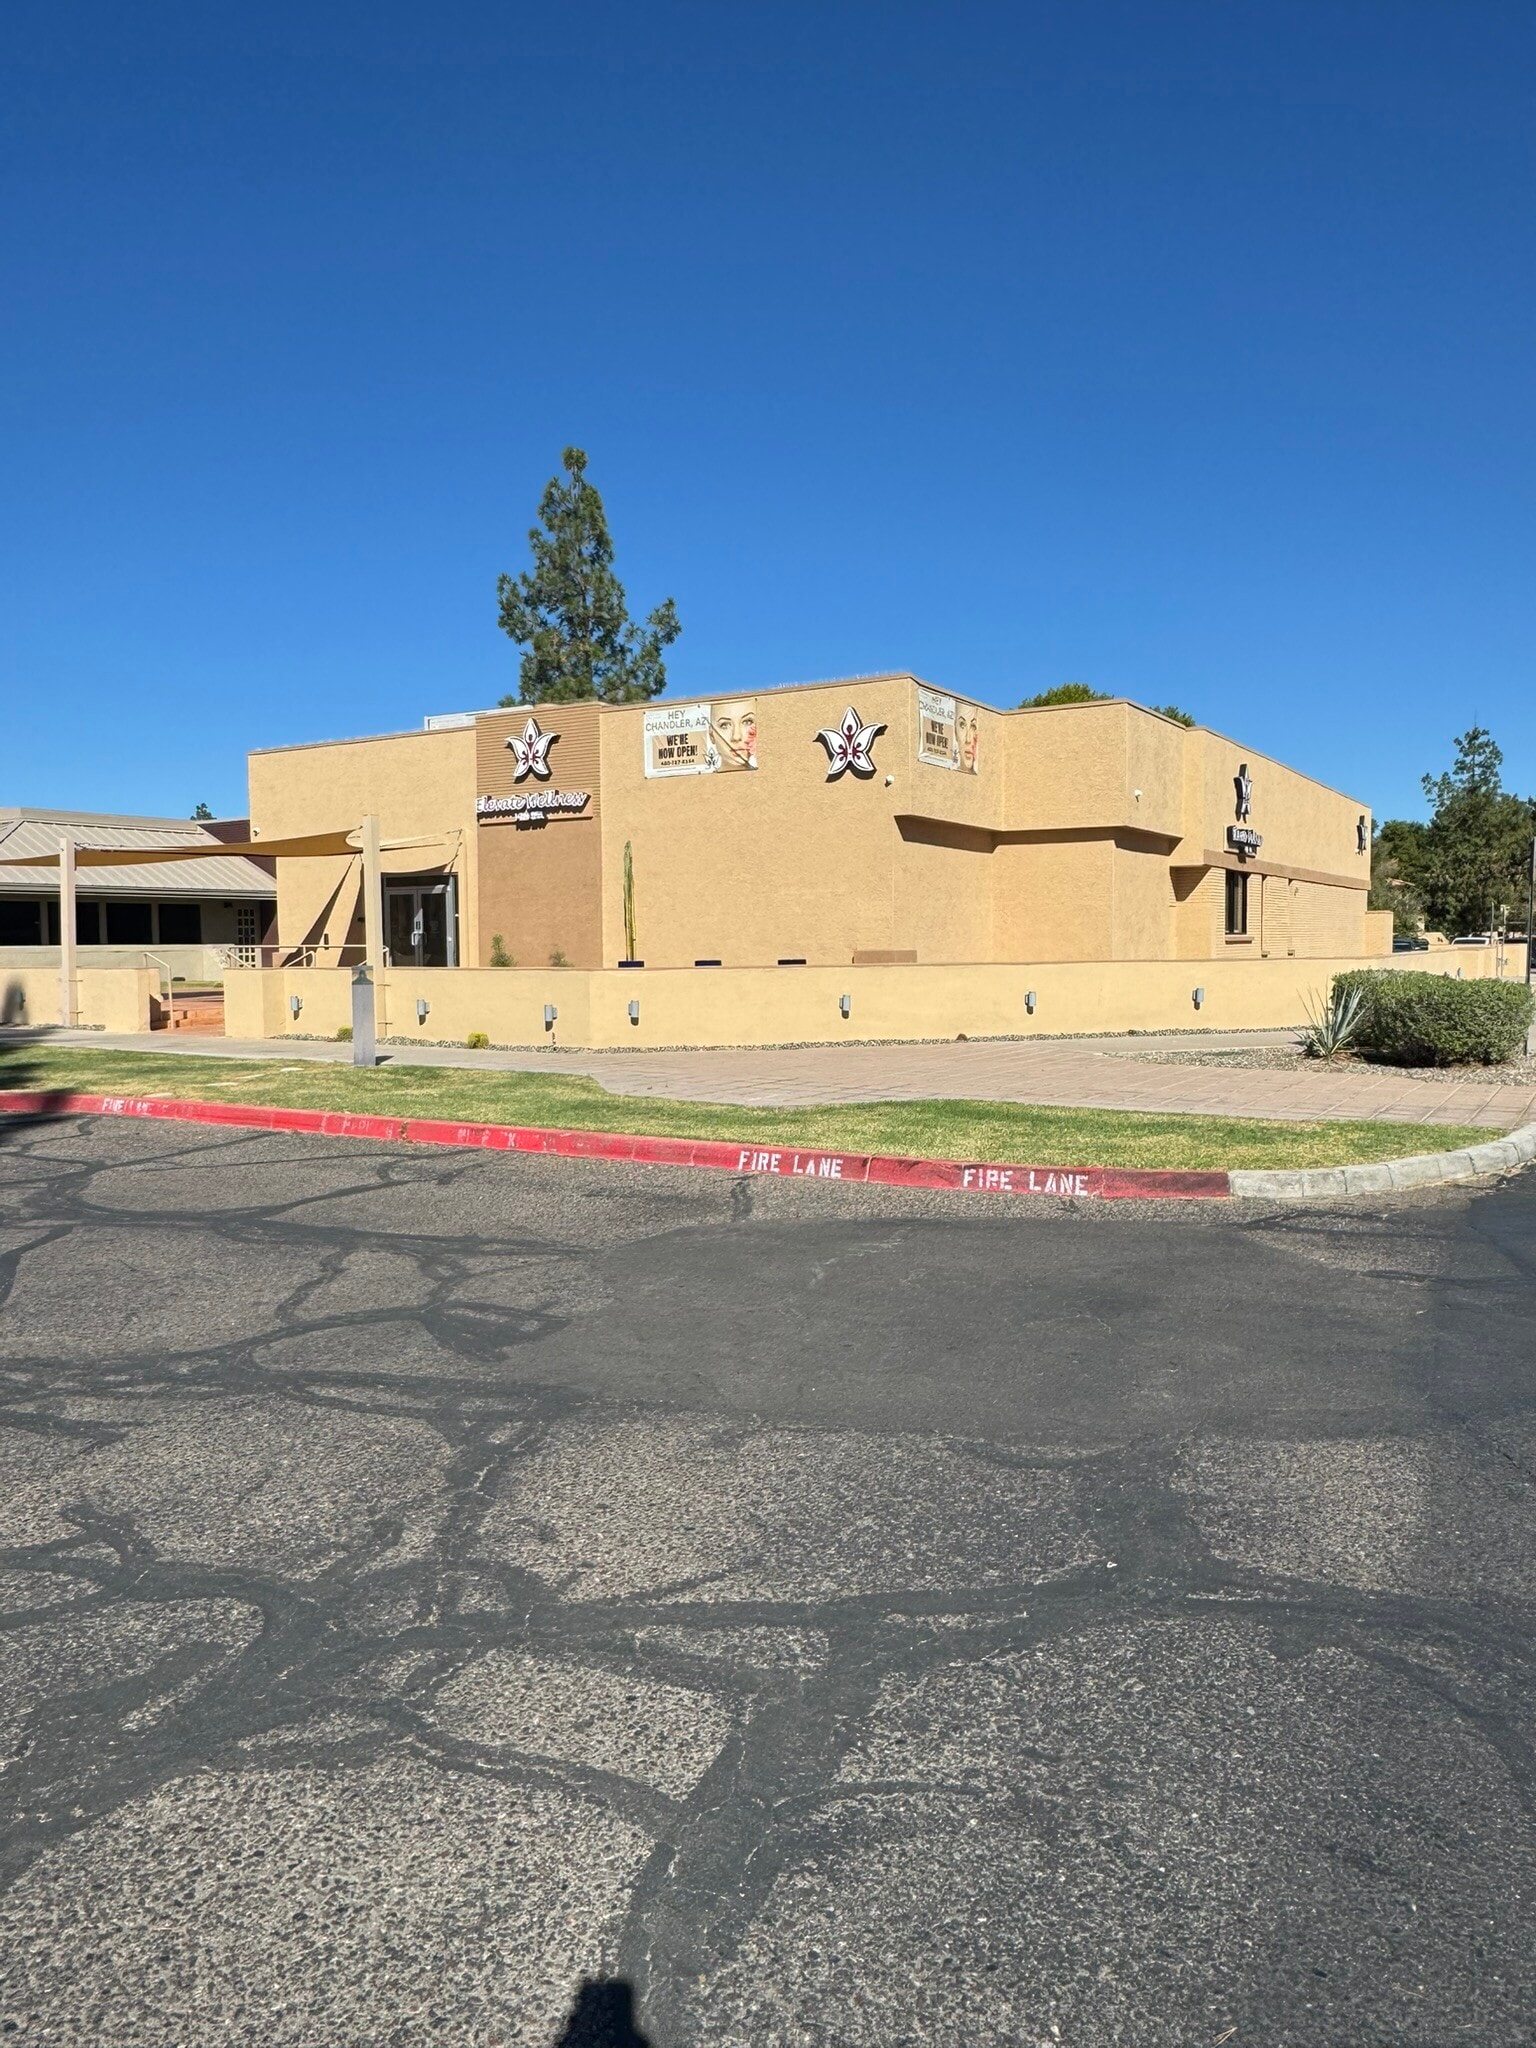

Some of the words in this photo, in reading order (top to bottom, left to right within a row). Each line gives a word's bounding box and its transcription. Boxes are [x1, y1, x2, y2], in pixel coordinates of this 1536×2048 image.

[667, 710, 686, 720] HEY
[645, 720, 693, 732] CHANDLER,
[695, 716, 707, 726] AZ
[666, 733, 688, 746] WE'RE
[658, 747, 675, 759] NOW
[677, 745, 698, 757] OPEN!
[476, 795, 526, 812] Elevate
[525, 789, 587, 808] Wellness
[738, 1150, 782, 1173] FIRE
[792, 1155, 844, 1179] LANE
[962, 1168, 1013, 1192] FIRE
[1028, 1170, 1090, 1196] LANE
